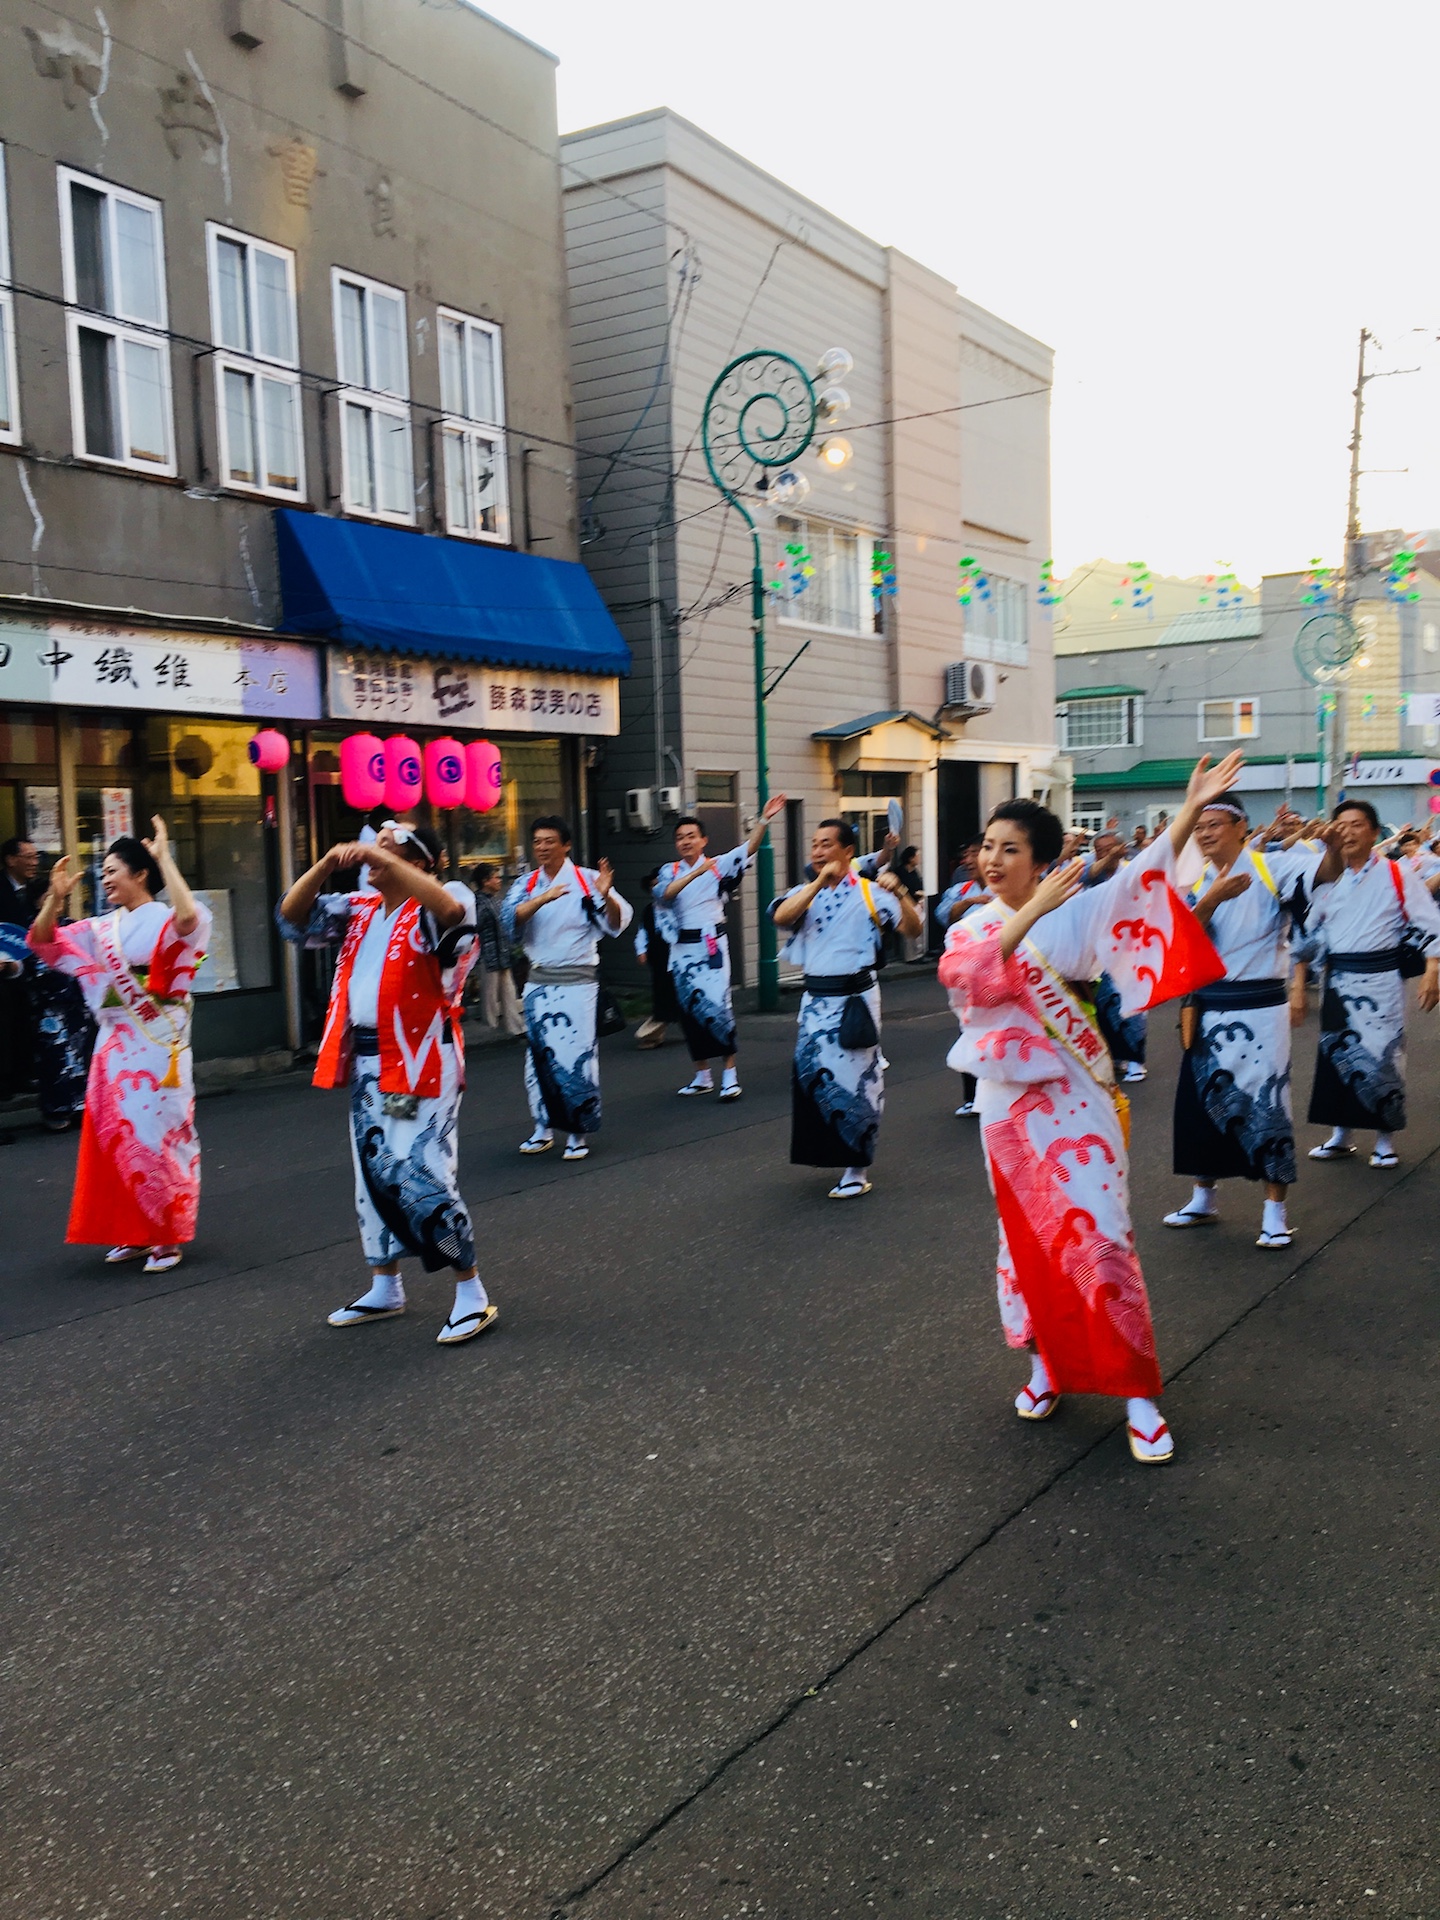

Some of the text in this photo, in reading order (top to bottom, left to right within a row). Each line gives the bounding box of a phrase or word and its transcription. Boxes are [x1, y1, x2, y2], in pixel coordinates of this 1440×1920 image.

[232, 665, 289, 695] 本店
[489, 685, 601, 717] 藤森茂男の店
[388, 904, 421, 961] おたる
